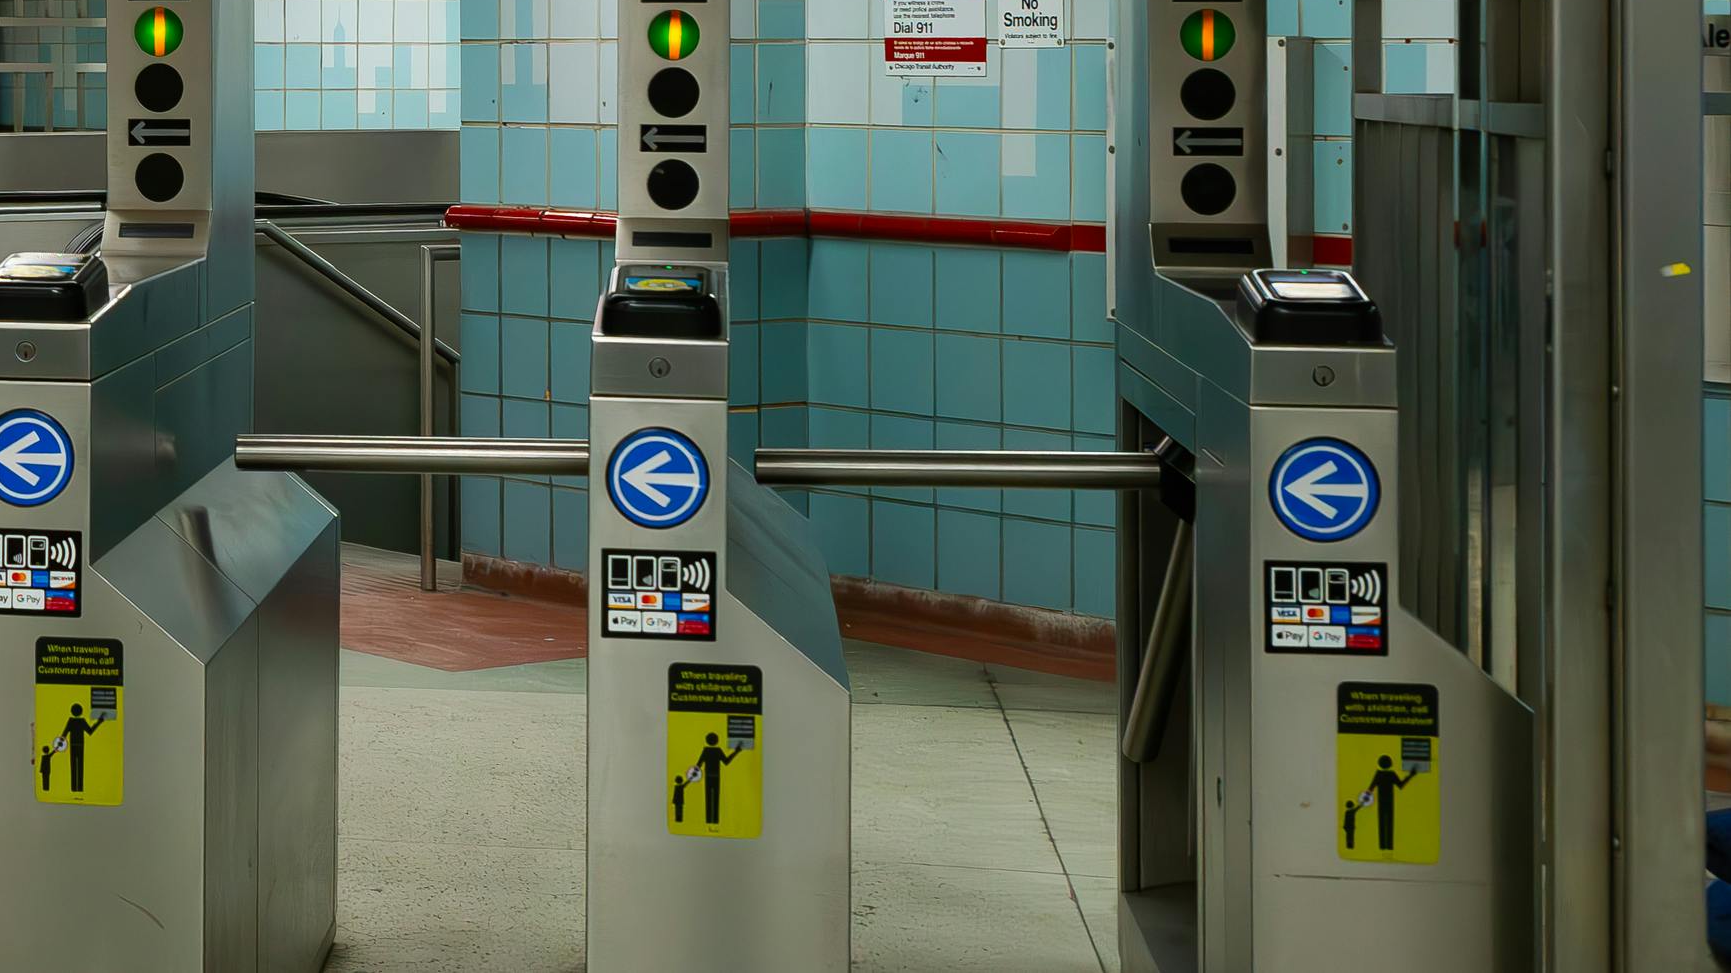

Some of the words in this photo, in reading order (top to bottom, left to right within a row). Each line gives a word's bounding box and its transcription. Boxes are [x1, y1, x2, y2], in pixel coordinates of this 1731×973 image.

[1003, 11, 1058, 31] Smoking
[893, 22, 913, 34] Dial
[916, 22, 934, 34] 911
[1702, 23, 1731, 48] le
[932, 63, 955, 71] Authority
[26, 594, 41, 605] Pay
[1276, 609, 1298, 617] VISA
[620, 616, 638, 627] Pay
[1285, 631, 1304, 643] Pay
[47, 644, 72, 653] When
[73, 645, 109, 655] traveling
[99, 657, 115, 665] call
[38, 666, 79, 675] Customer
